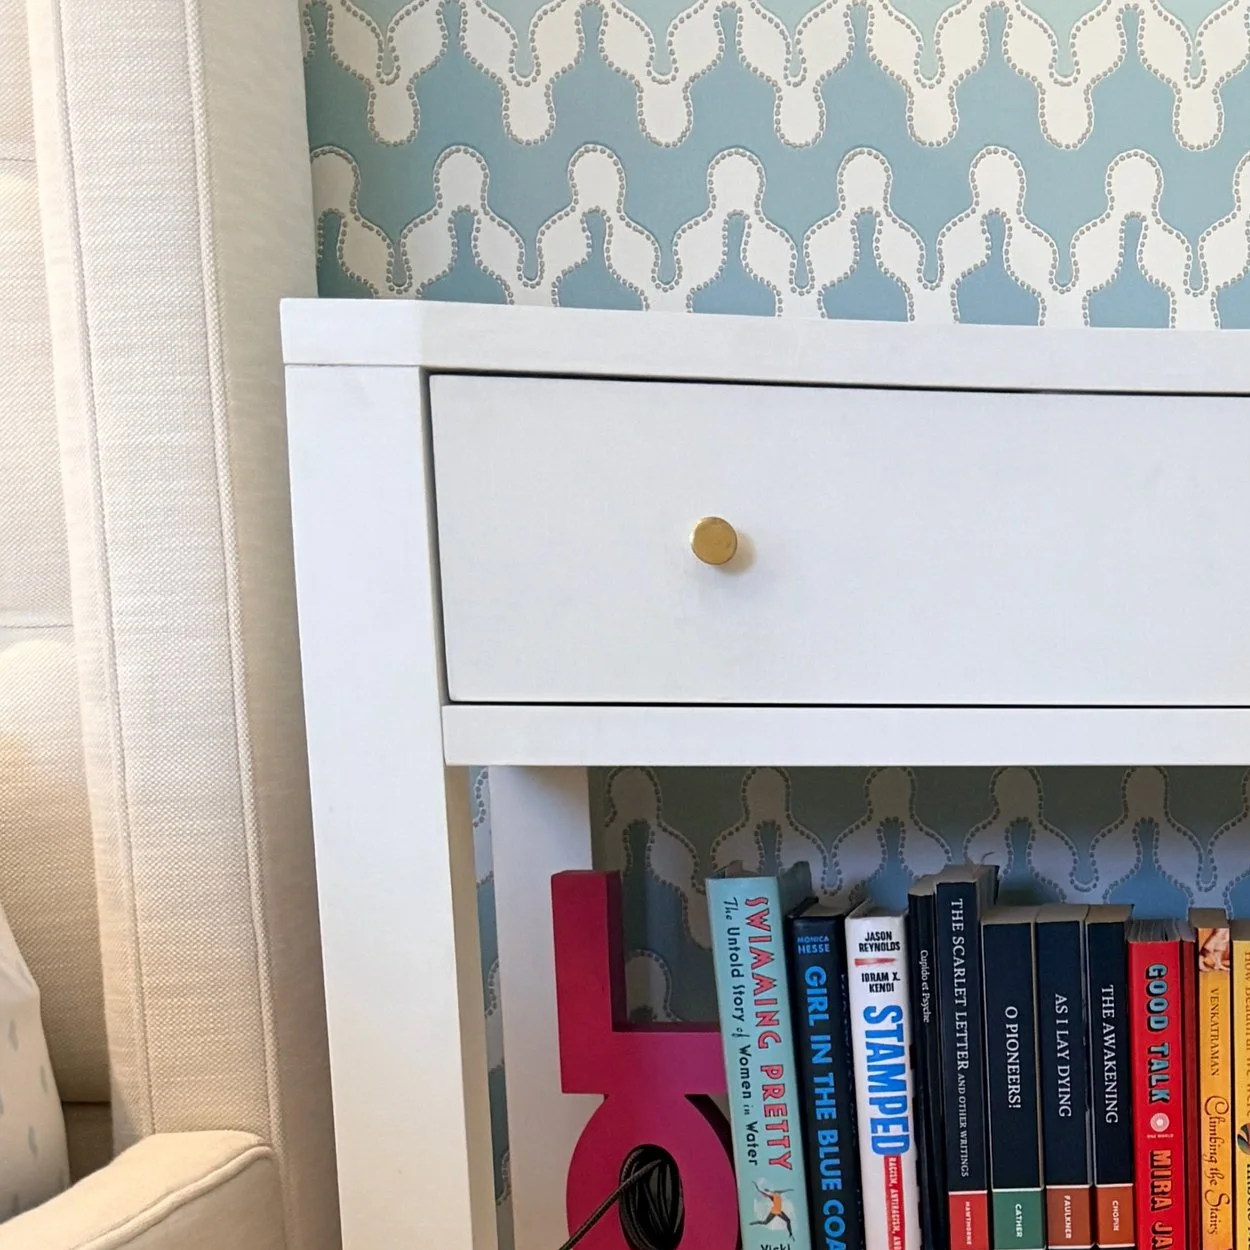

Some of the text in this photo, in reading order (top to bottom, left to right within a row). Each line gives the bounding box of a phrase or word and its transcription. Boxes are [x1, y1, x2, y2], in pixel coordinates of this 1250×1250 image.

[723, 897, 739, 921] The
[727, 927, 744, 978] Untold
[798, 944, 830, 954] HESSE
[859, 942, 900, 952] REYNOLDS
[865, 931, 892, 941] JASON
[805, 965, 830, 1027] GIRL
[862, 973, 889, 982] IBRAM
[869, 983, 894, 993] KENDI
[919, 950, 931, 1023] Cupido et Psyche
[732, 986, 745, 1022] Story
[1055, 994, 1068, 1014] AS
[744, 896, 793, 1171] SWIMMING PRETTY
[810, 1035, 833, 1064] IN
[951, 898, 969, 1177] THE SCARLET LETTER AND OTHER WRITINGS
[1056, 1030, 1070, 1060] LAY
[1101, 984, 1118, 1124] THE AWAKENING
[1145, 963, 1170, 1104] GOOD TALK
[1210, 987, 1220, 1076] VENKATRAMAN
[739, 1044, 752, 1099] Women
[863, 1005, 911, 1155] STAMPED
[1005, 1006, 1021, 1108] O PIONEERS!
[743, 1104, 754, 1115] in
[813, 1072, 837, 1120] THE
[1057, 1065, 1072, 1117] DYING
[746, 1121, 759, 1166] Water
[817, 1129, 842, 1191] BLUE
[1204, 1095, 1230, 1235] Climbing the Stairs
[1150, 1149, 1173, 1212] MIRA
[1015, 1203, 1023, 1238] CATHER
[1064, 1195, 1072, 1239] FAULKNER
[894, 1236, 902, 1250] AND
